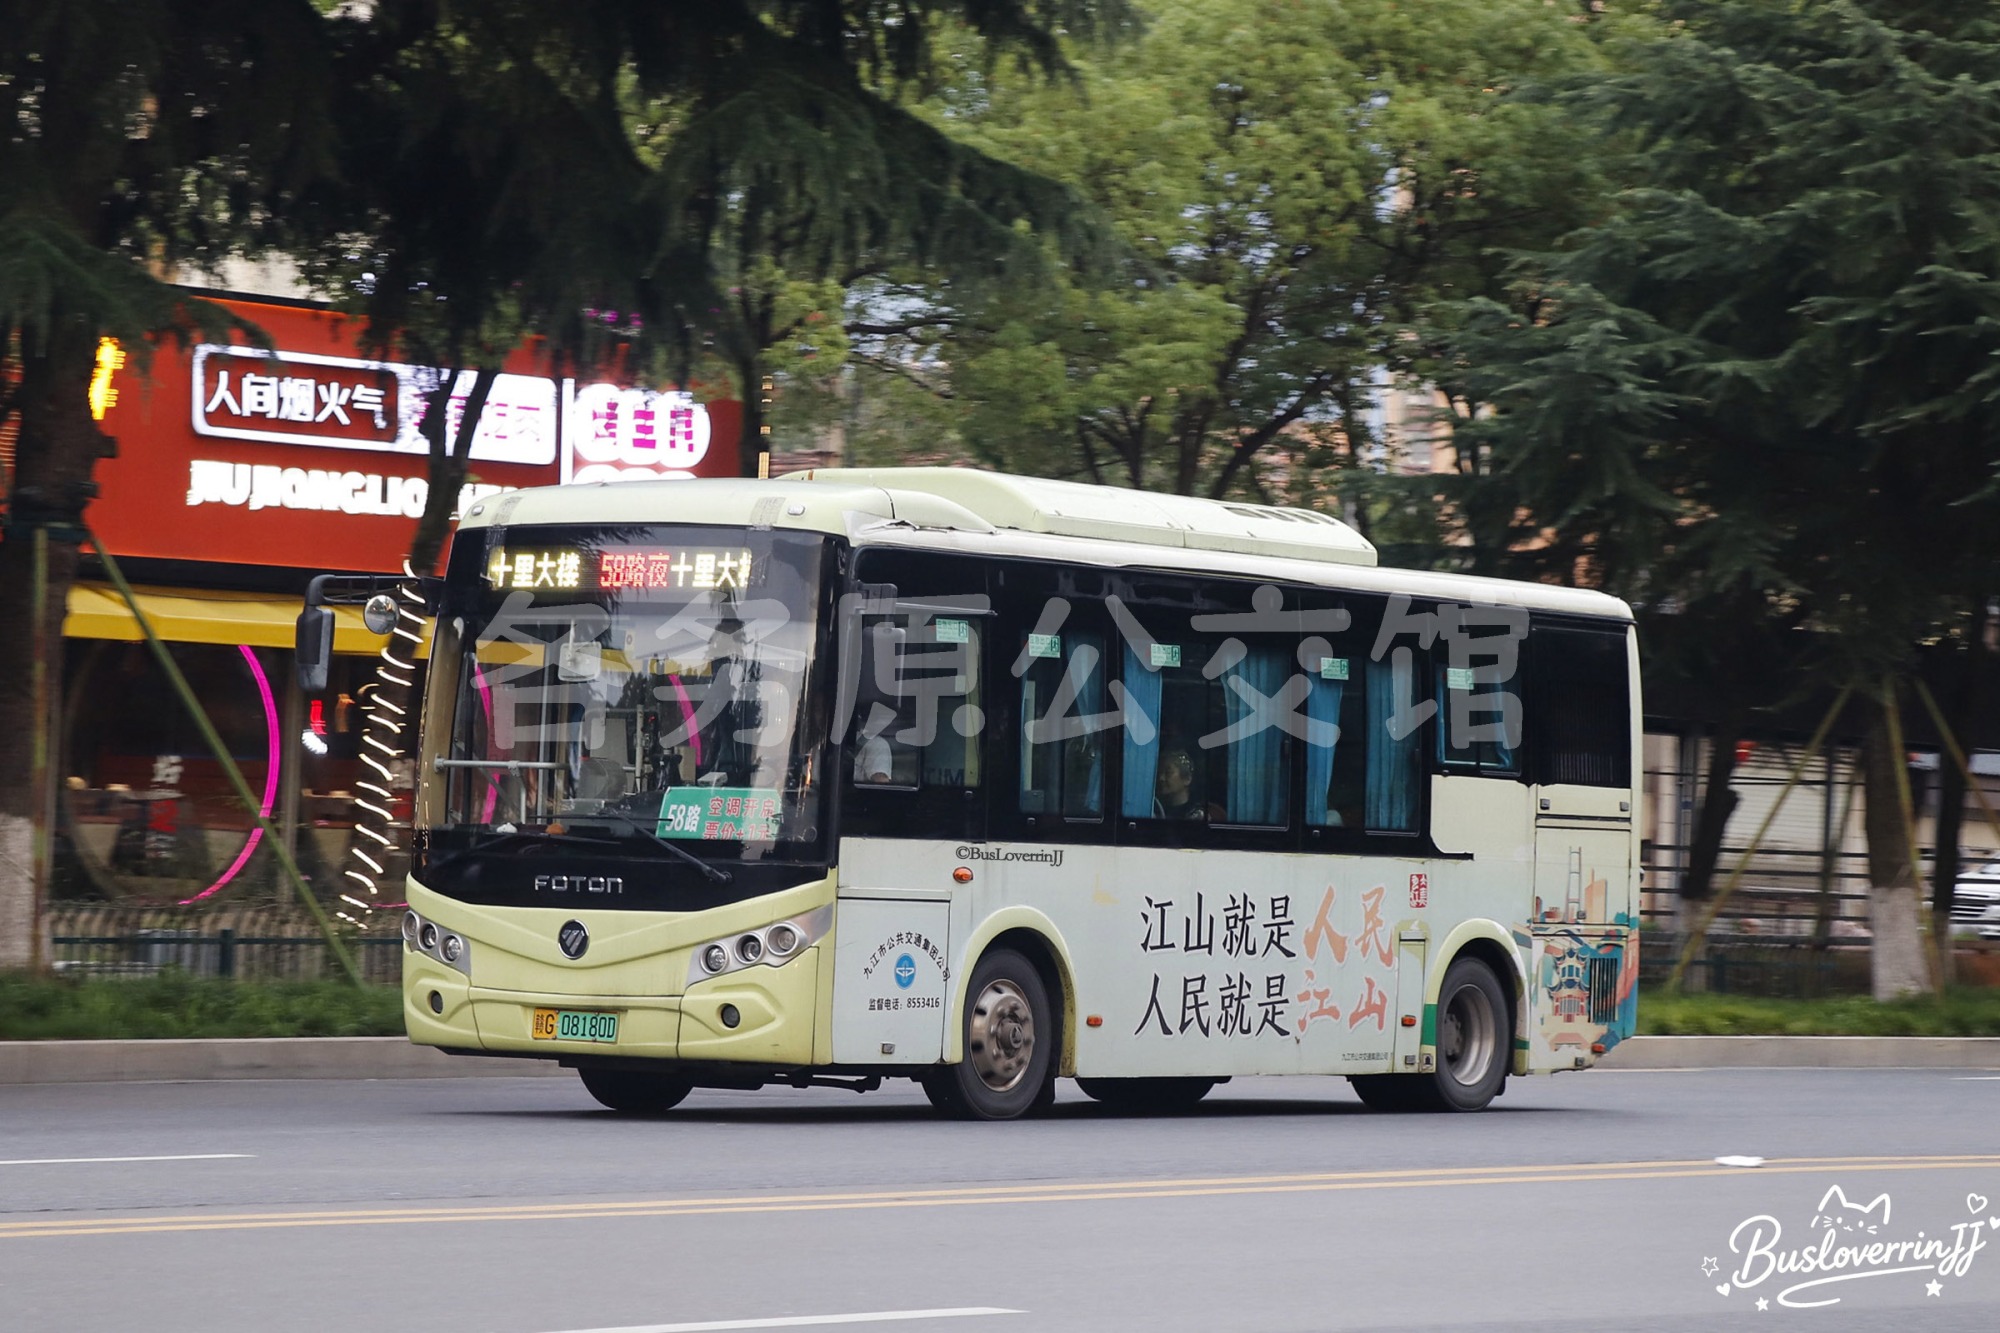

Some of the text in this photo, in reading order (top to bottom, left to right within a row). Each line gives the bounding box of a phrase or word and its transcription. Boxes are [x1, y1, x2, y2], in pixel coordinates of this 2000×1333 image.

[205, 370, 387, 429] 人间烟火气
[491, 552, 581, 587] 十里大楼
[665, 804, 702, 832] 58路
[535, 875, 623, 893] FOTON
[1140, 885, 1394, 967] 江山就是人民
[863, 931, 951, 981] 九江市公共交通集团公司
[1134, 970, 1388, 1038] 人民就是江山
